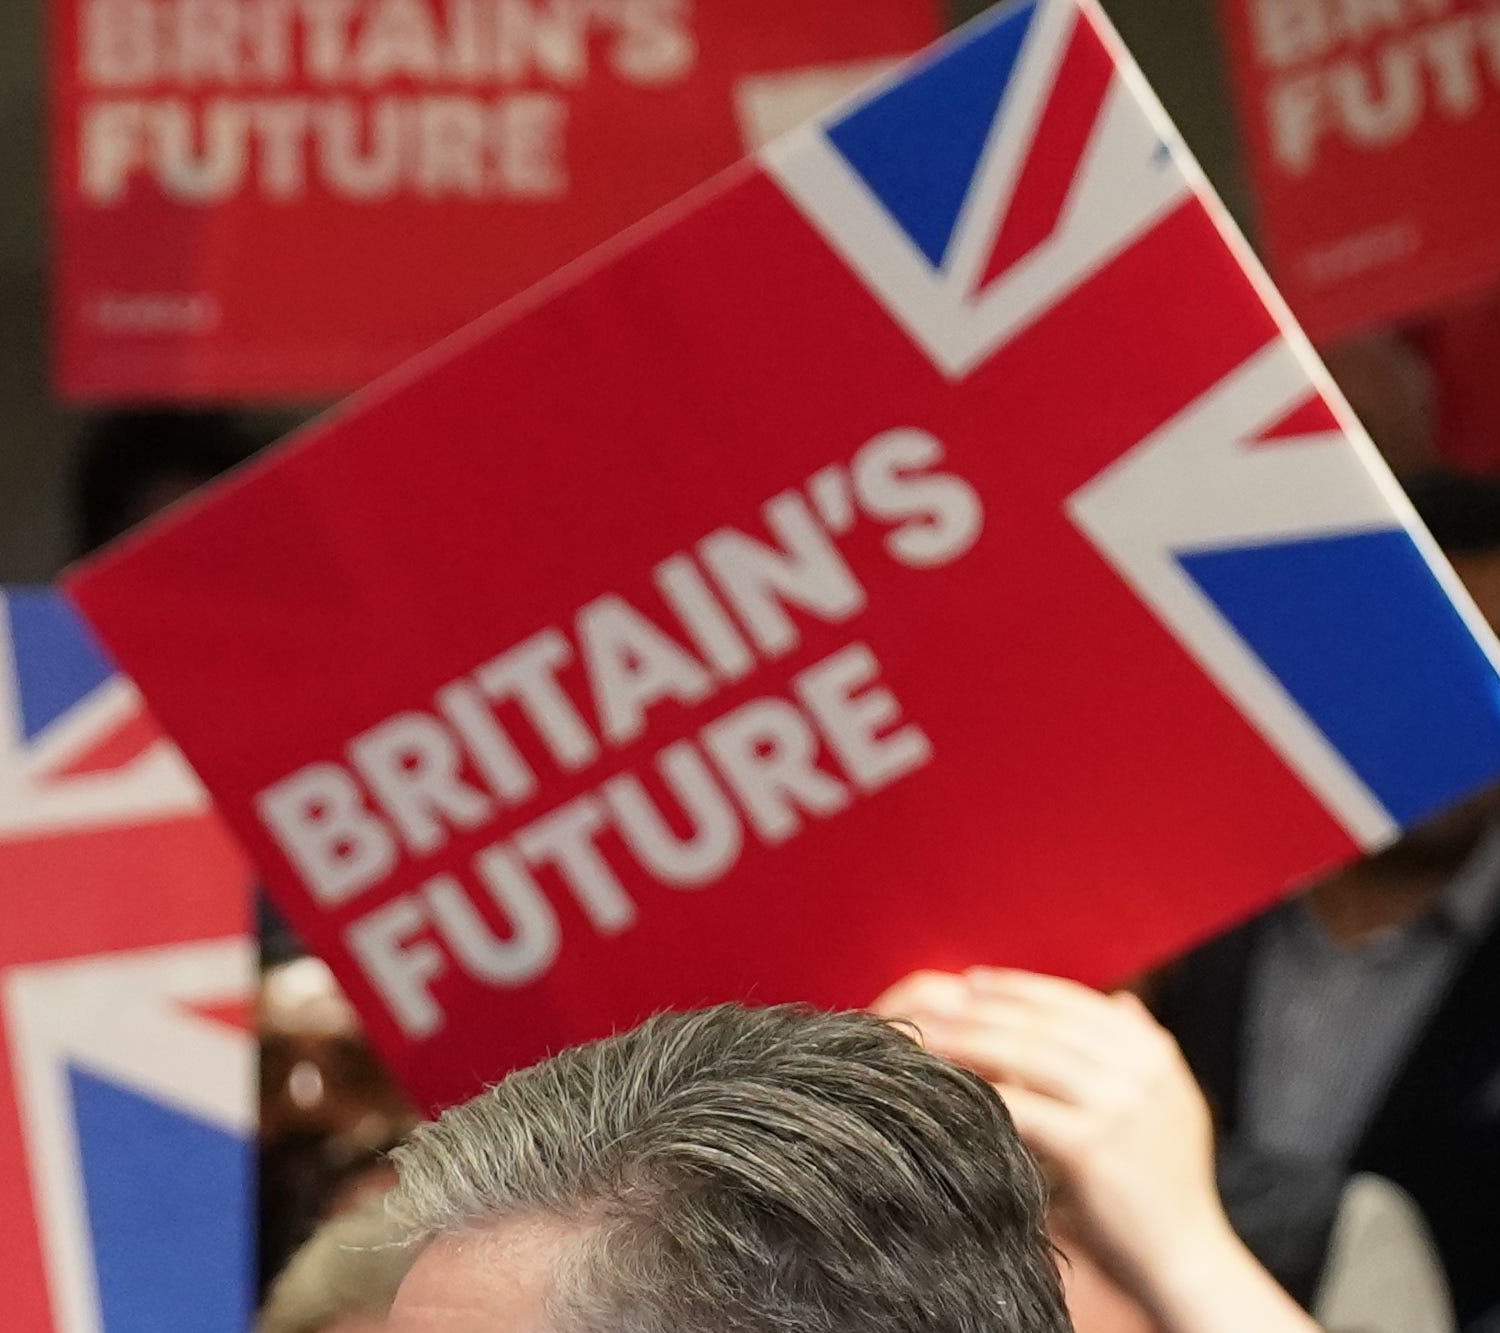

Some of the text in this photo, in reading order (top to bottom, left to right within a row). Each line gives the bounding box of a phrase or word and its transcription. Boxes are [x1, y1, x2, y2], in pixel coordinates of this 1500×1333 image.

[81, 93, 564, 202] FUTURE
[253, 426, 984, 907] BRITAIN'S
[340, 641, 934, 1042] FUTURE
